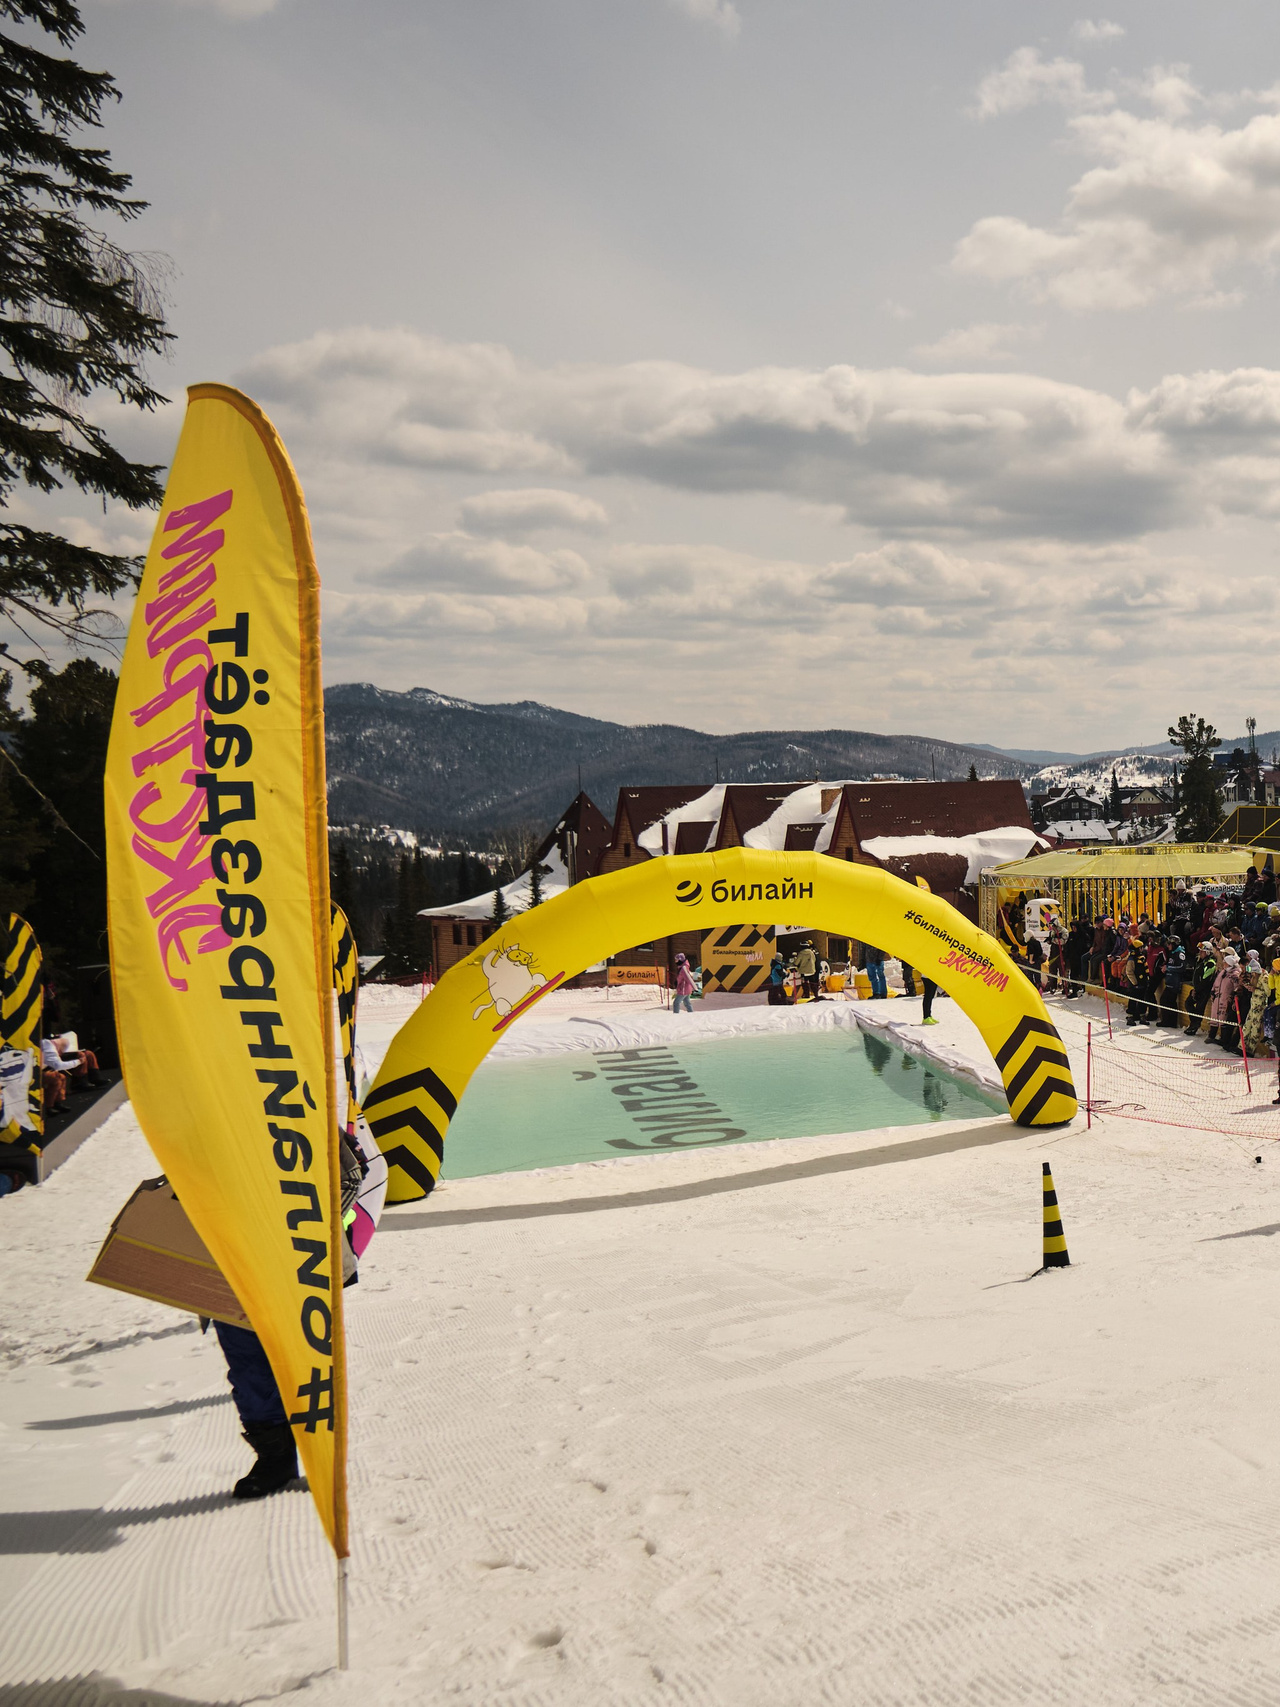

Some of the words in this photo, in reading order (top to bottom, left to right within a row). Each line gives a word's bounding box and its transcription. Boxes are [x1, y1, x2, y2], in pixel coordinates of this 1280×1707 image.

[711, 877, 813, 903] билайн
[904, 909, 995, 970] #билайнраздаёт
[626, 970, 656, 979] билайн
[938, 950, 1010, 993] ЭКСТРИМ
[571, 1045, 748, 1151] билайн
